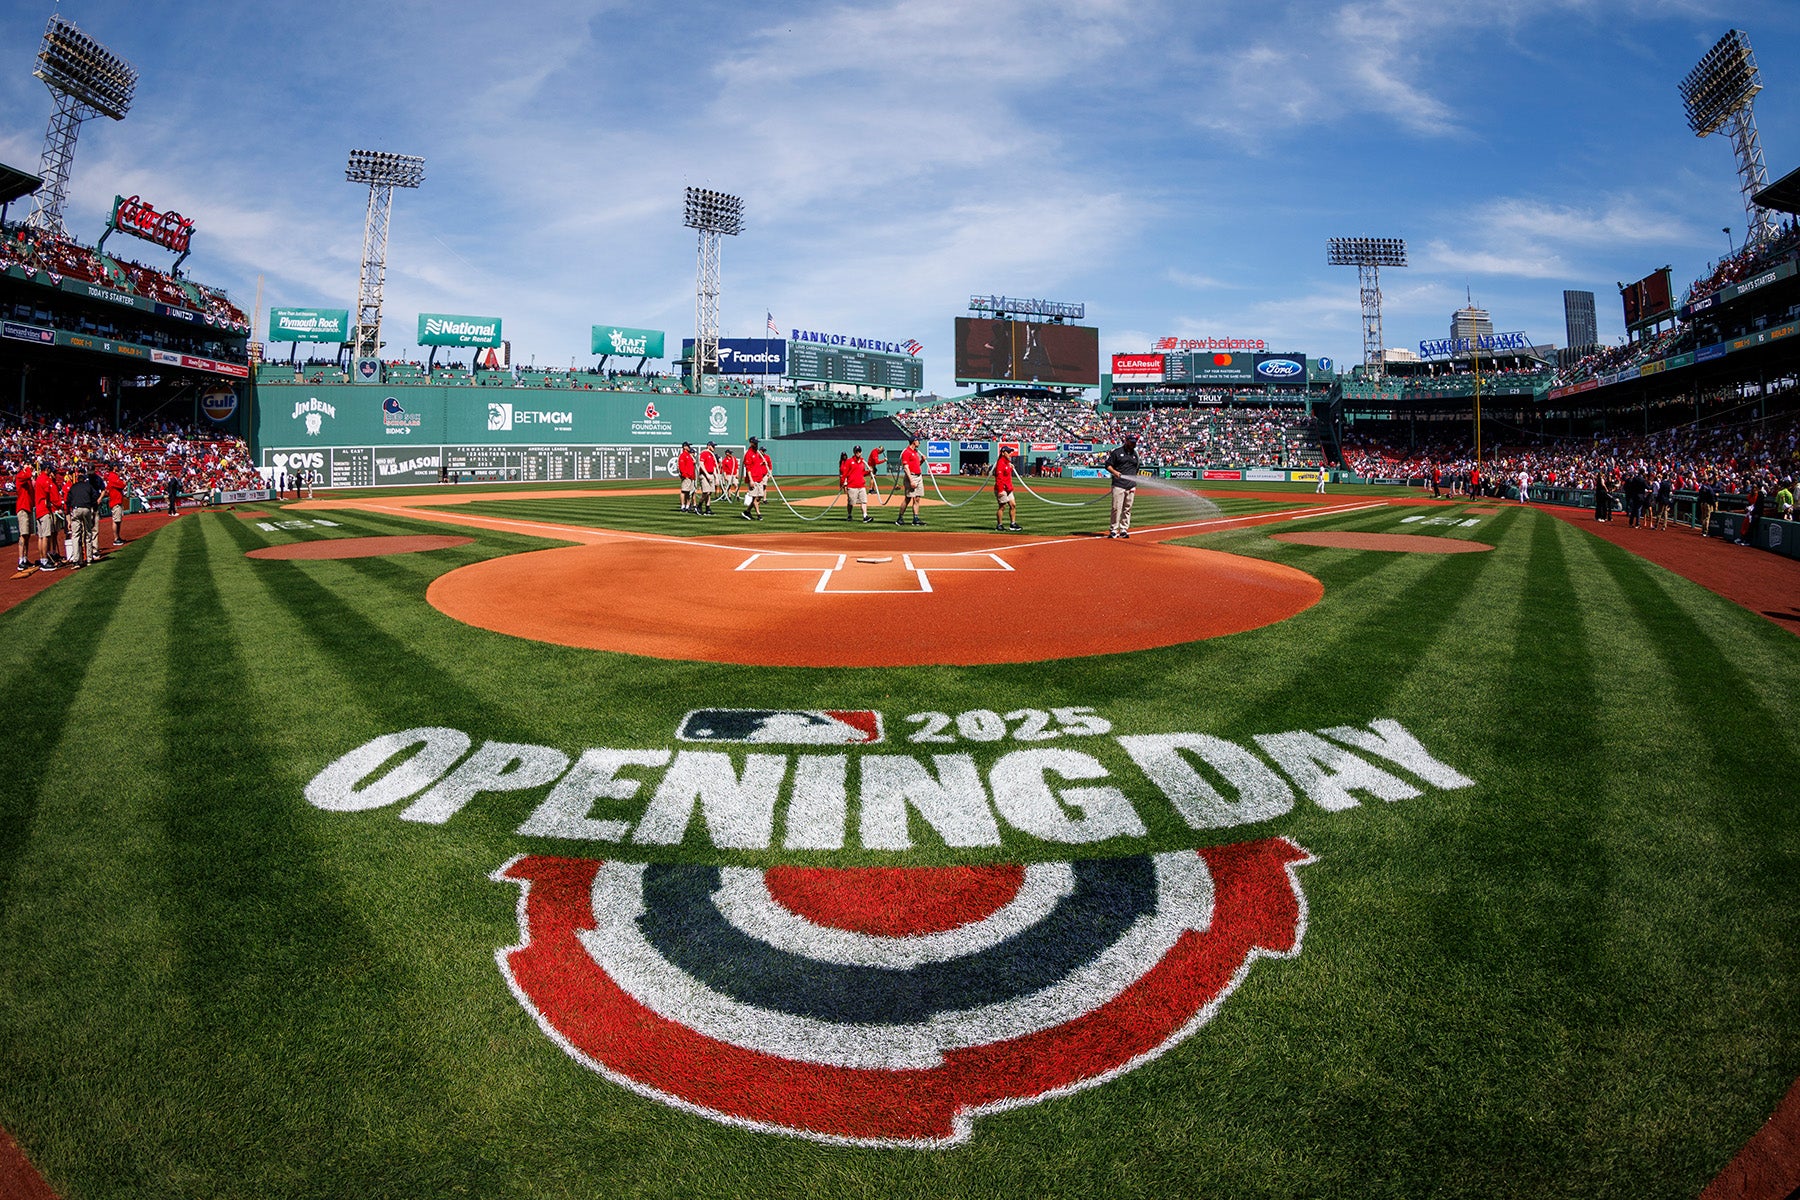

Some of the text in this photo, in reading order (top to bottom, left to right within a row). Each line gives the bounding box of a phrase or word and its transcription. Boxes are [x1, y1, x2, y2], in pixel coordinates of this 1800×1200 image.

[116, 195, 194, 252] Coca-Cola
[1737, 272, 1776, 294] TODAY'S STARTERS
[88, 286, 134, 305] TODAY'S STARTERS
[990, 294, 1085, 318] MassMutual
[279, 317, 339, 328] Plymouth Rock
[441, 321, 496, 336] National.
[611, 337, 647, 347] DRAFT
[615, 345, 645, 354] KINGS
[792, 329, 900, 353] BANK OF AMERICA
[1180, 336, 1265, 349] new balance
[1420, 332, 1526, 358] SAMUEL ADAMS
[734, 351, 780, 362] Fanatics
[1265, 360, 1294, 374] Ford
[203, 395, 235, 408] Gulf
[292, 398, 336, 419] JIM BEAM
[514, 411, 572, 424] BETMGM
[288, 452, 324, 469] CVS
[905, 706, 1113, 744] 2025
[303, 717, 1476, 850] OPENING DAY
